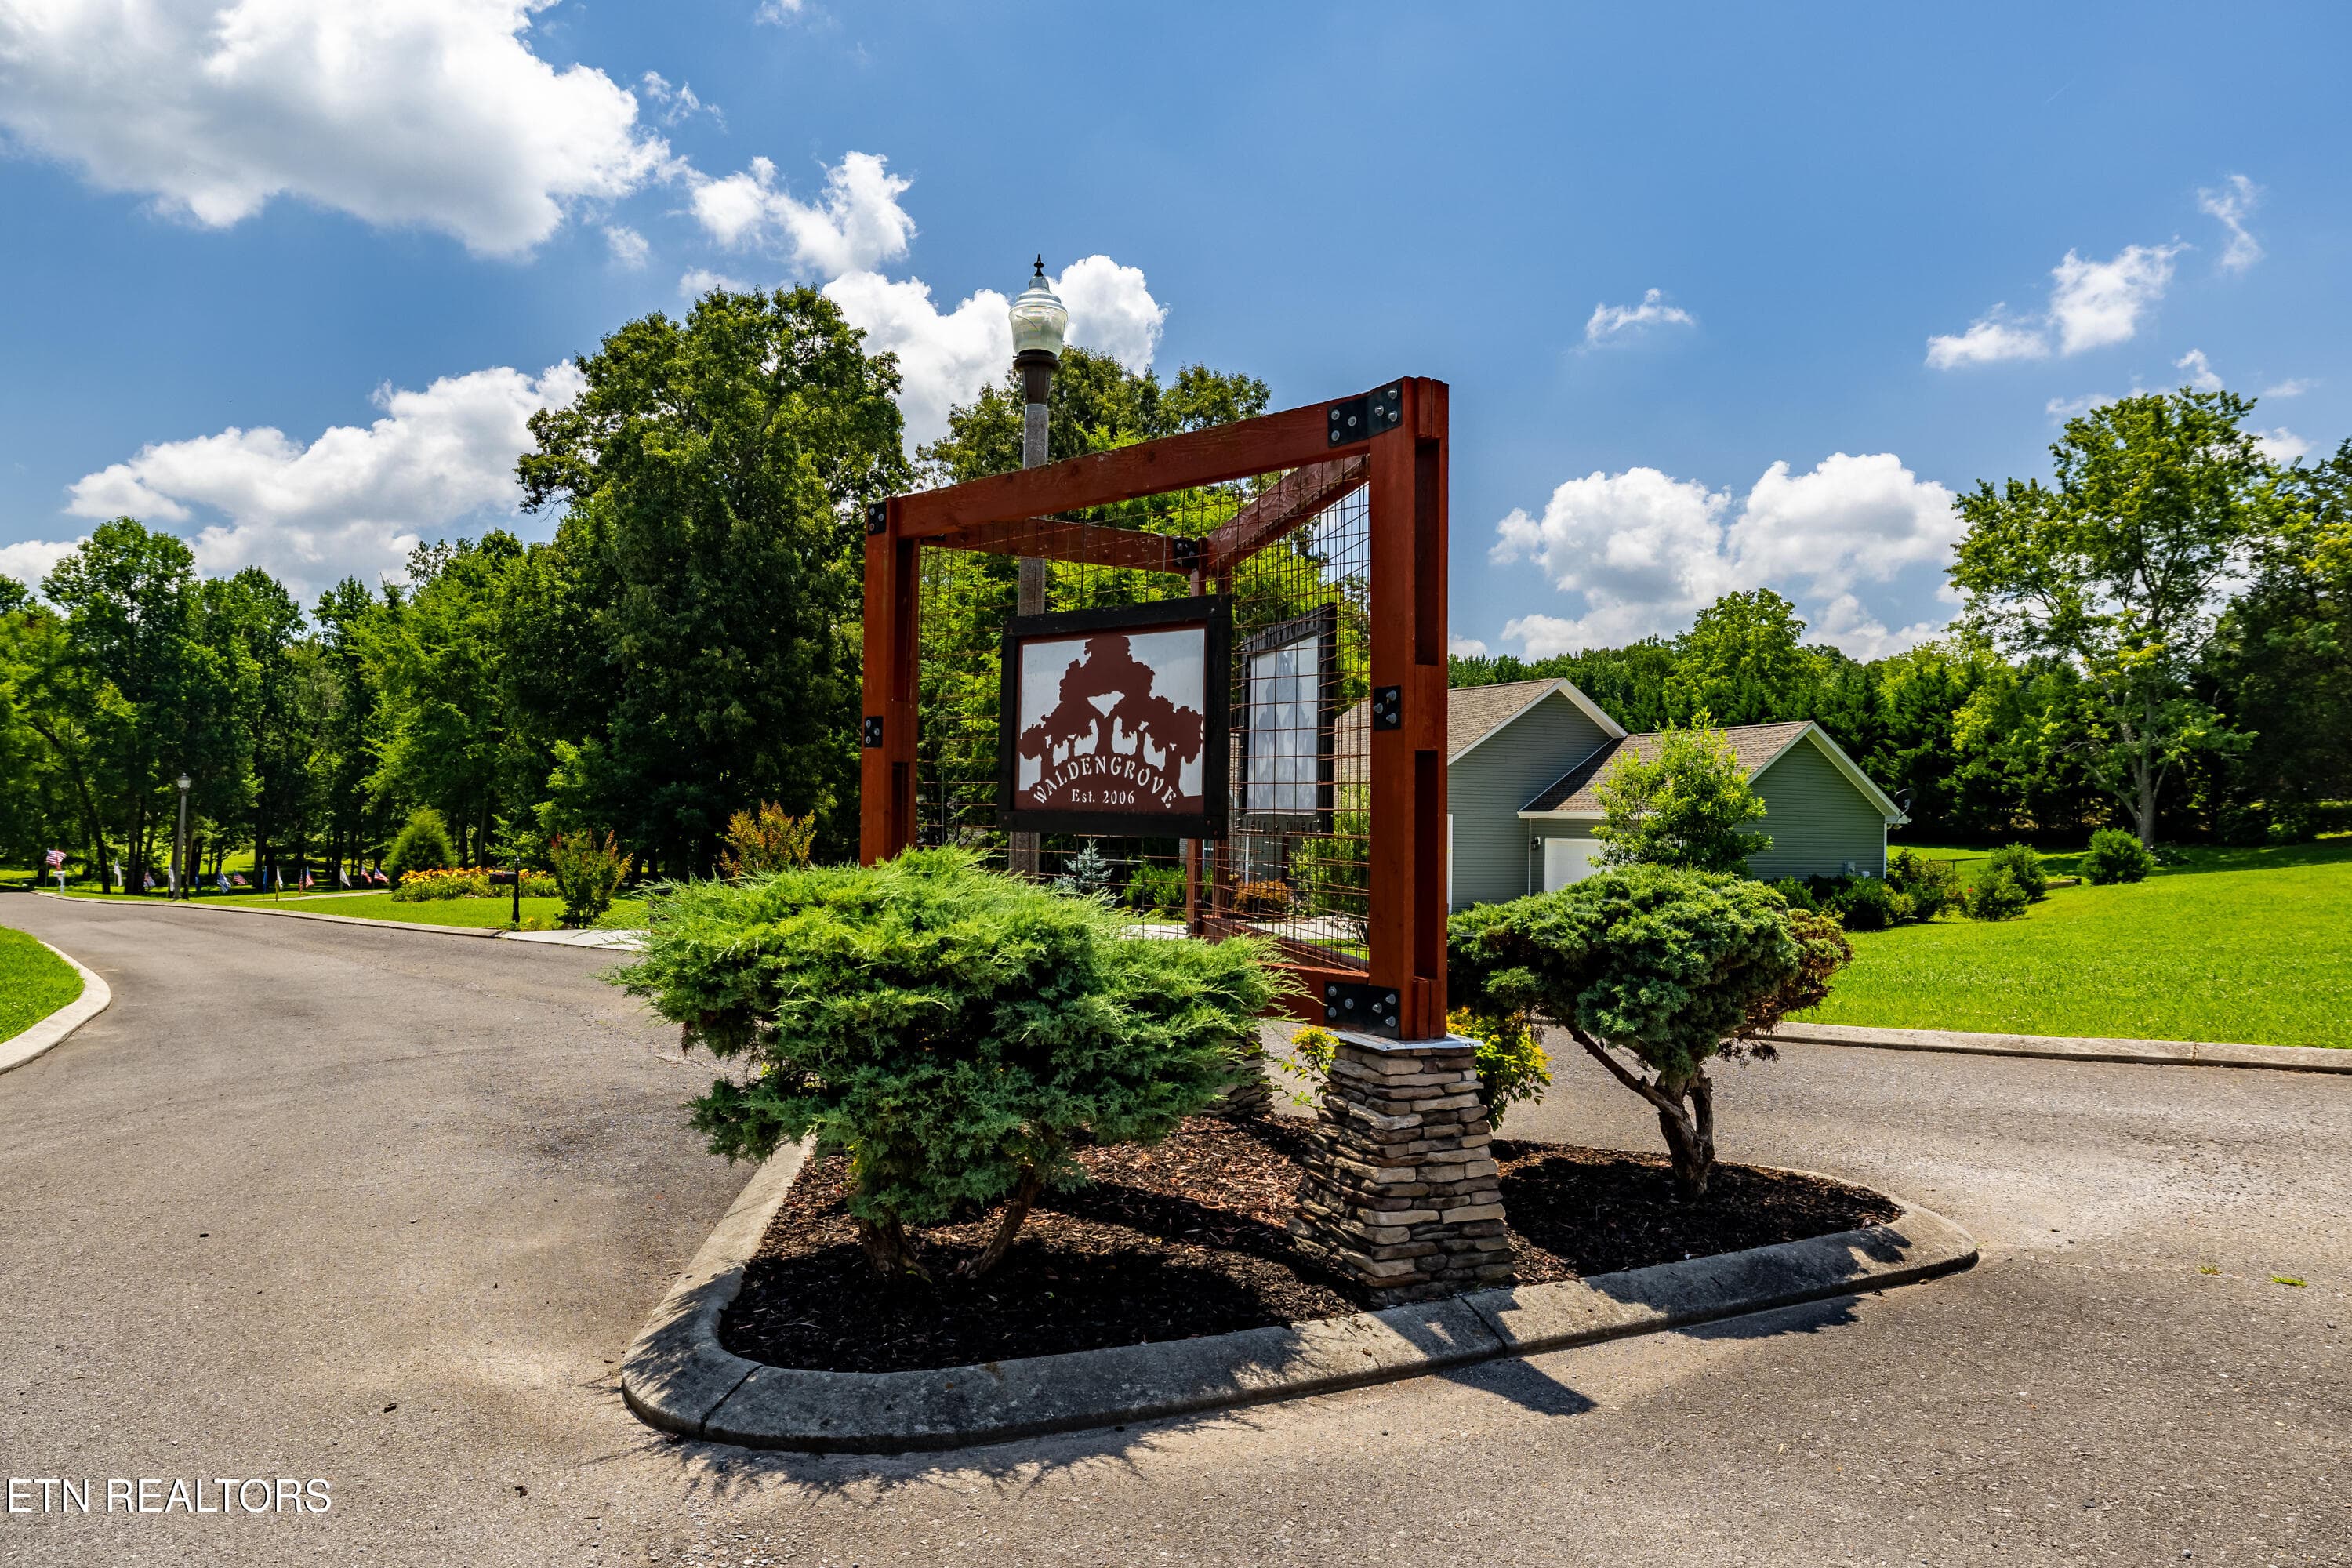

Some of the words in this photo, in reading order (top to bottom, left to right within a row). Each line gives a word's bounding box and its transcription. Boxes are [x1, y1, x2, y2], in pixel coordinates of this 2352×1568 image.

[1033, 755, 1177, 808] WALDENGROVE
[1071, 789, 1095, 803] Est.
[1102, 789, 1135, 804] 2006
